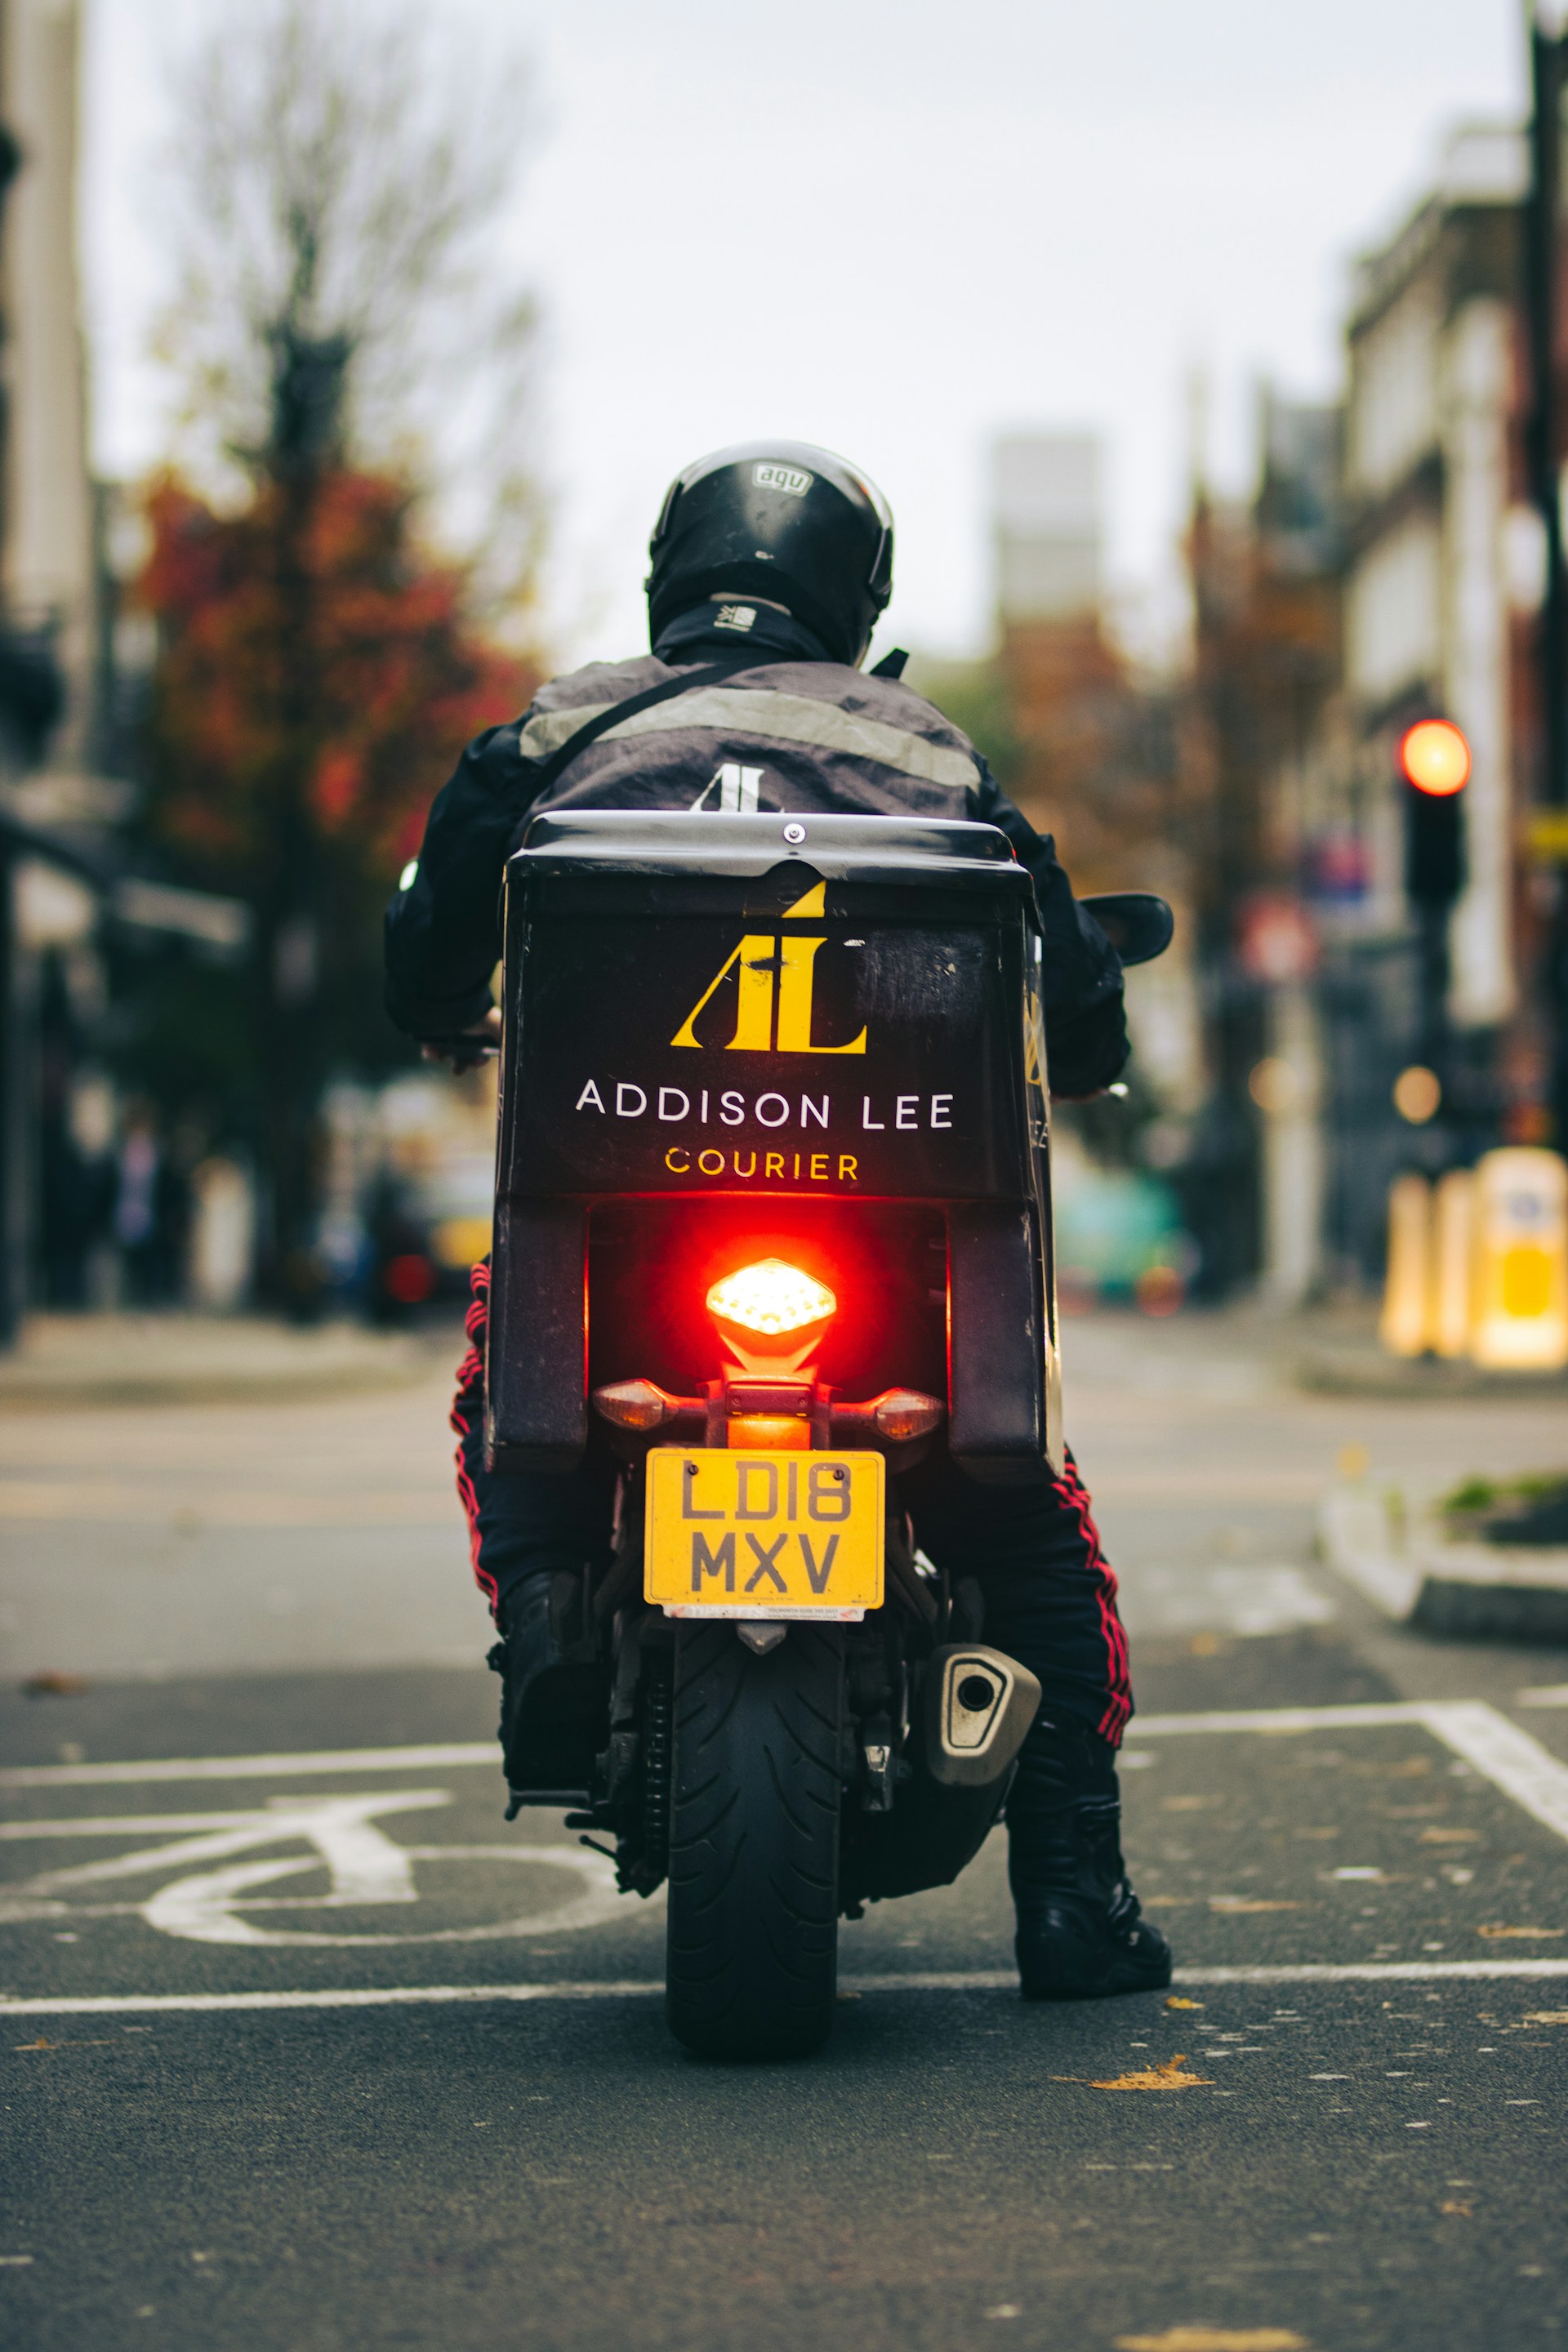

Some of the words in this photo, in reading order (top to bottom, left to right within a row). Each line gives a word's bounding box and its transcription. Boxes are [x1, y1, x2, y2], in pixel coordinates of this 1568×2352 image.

[760, 467, 805, 489] agv
[575, 1079, 831, 1129] ADDISON
[862, 1094, 954, 1130] LEE
[665, 1147, 858, 1181] COURIER
[682, 1459, 852, 1522] LD18
[691, 1531, 840, 1594] MXV
